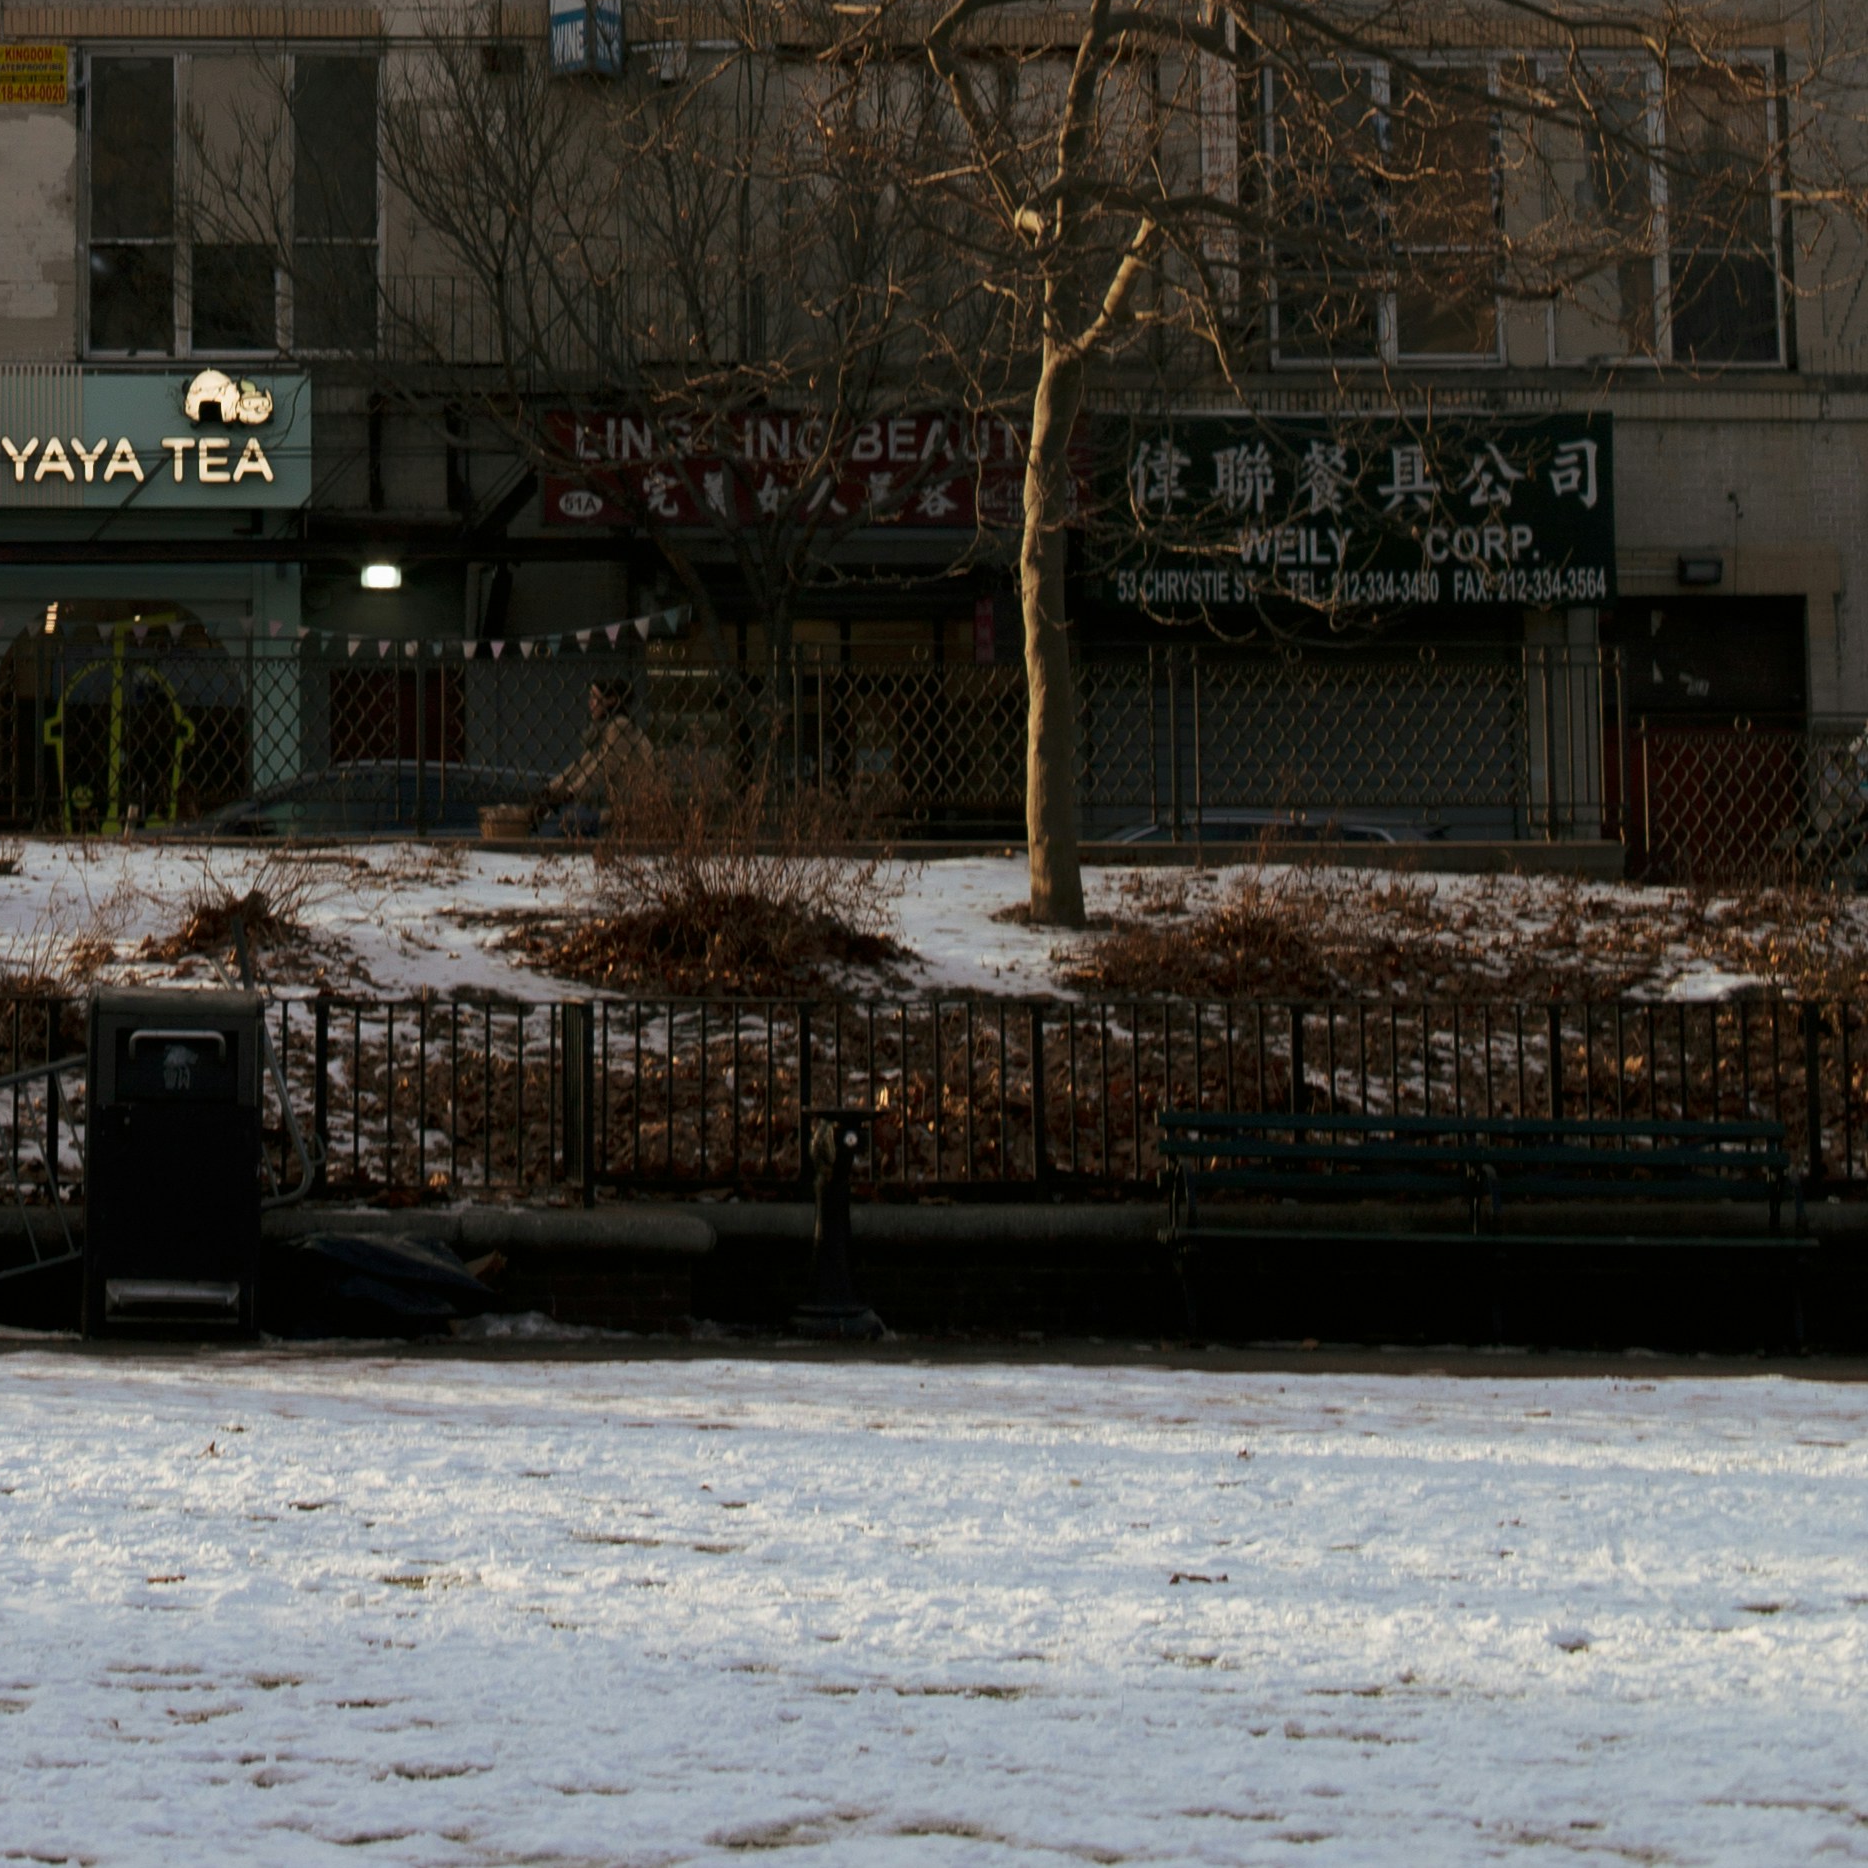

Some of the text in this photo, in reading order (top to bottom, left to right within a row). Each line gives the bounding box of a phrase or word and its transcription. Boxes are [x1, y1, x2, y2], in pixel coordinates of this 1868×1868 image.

[5, 47, 53, 62] KINGDOM
[0, 435, 275, 484] YAYA TEA
[850, 418, 1035, 463] BEAUT
[564, 496, 597, 513] 51A
[1236, 523, 1541, 565] WEILY CORP.
[1117, 569, 1137, 604] 53
[1141, 568, 1231, 604] CHRYSTIE
[1286, 568, 1327, 604] TEL:
[1498, 566, 1607, 601] 212-334-3564
